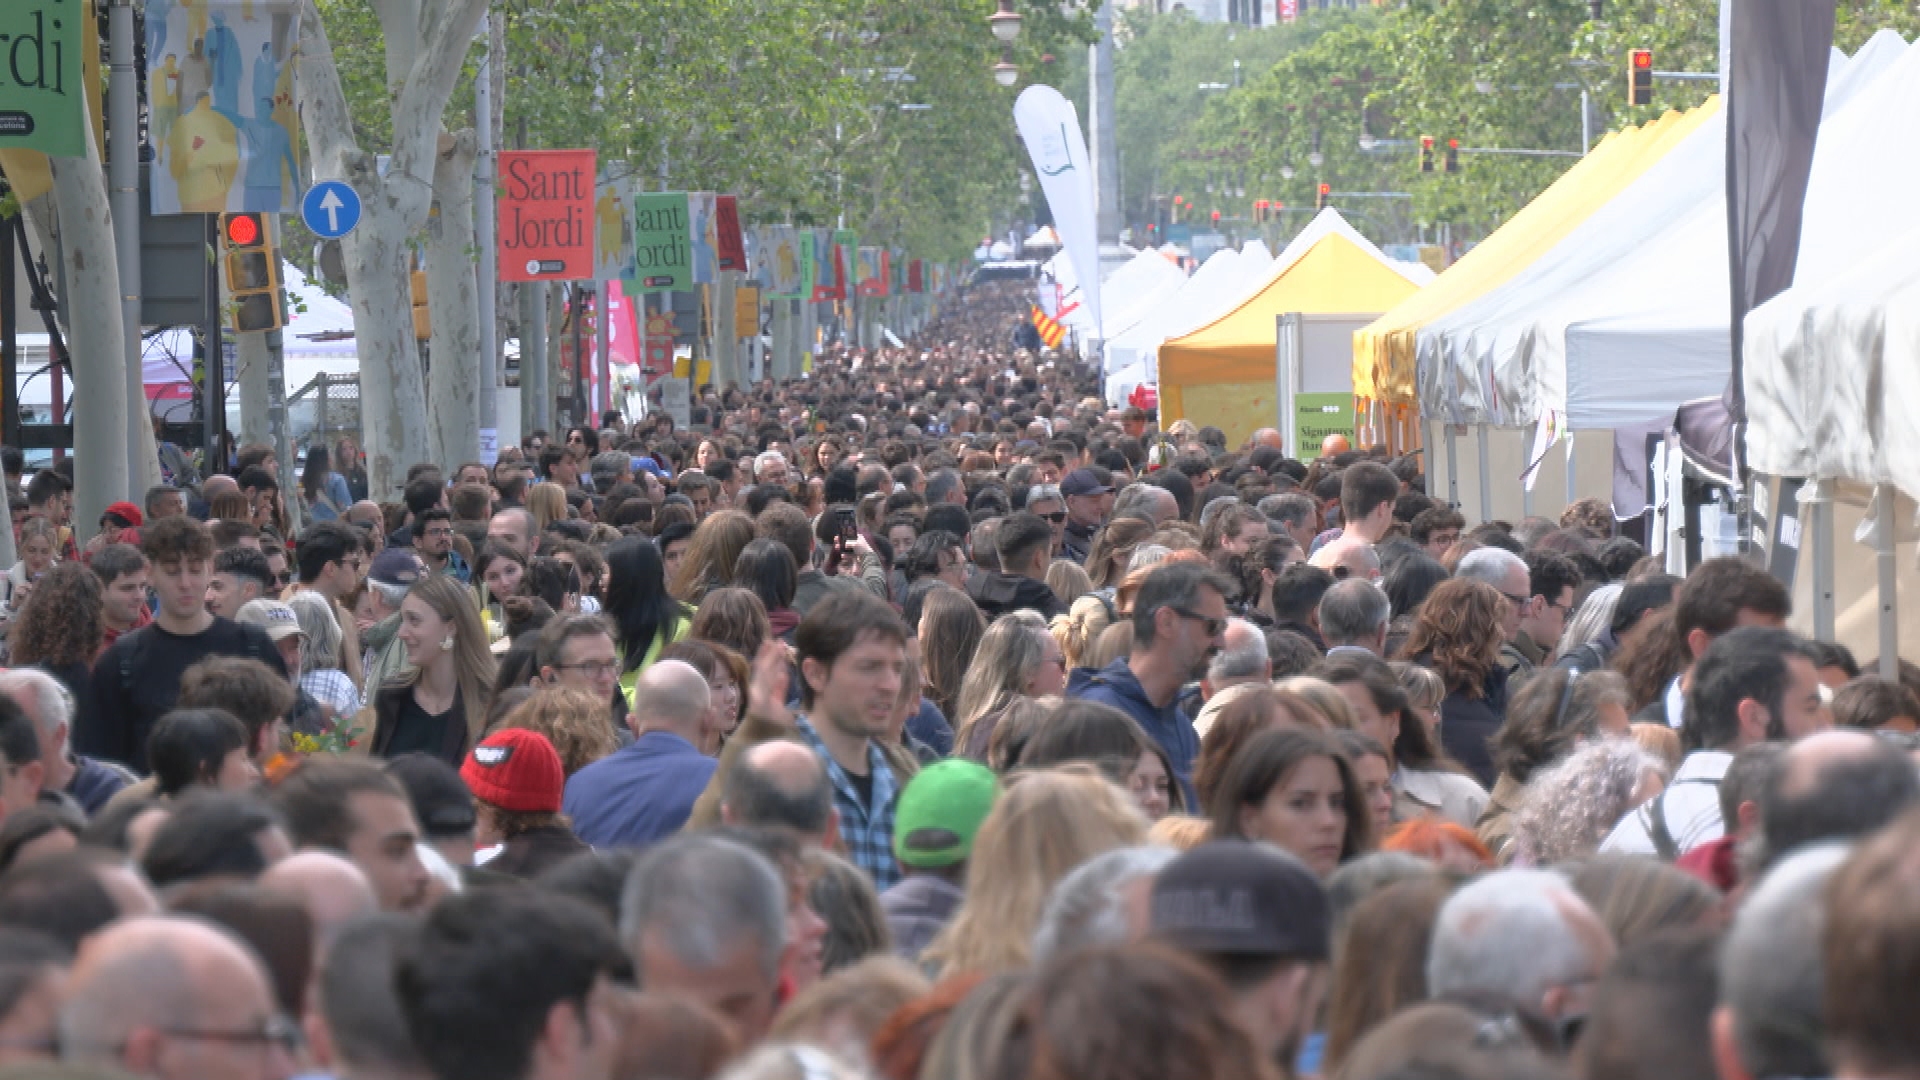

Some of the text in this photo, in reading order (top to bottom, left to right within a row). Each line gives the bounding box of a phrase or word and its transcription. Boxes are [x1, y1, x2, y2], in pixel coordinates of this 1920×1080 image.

[508, 158, 585, 202] Sant
[504, 205, 584, 249] Jordi
[635, 202, 685, 232] ant
[636, 234, 685, 268] ordi
